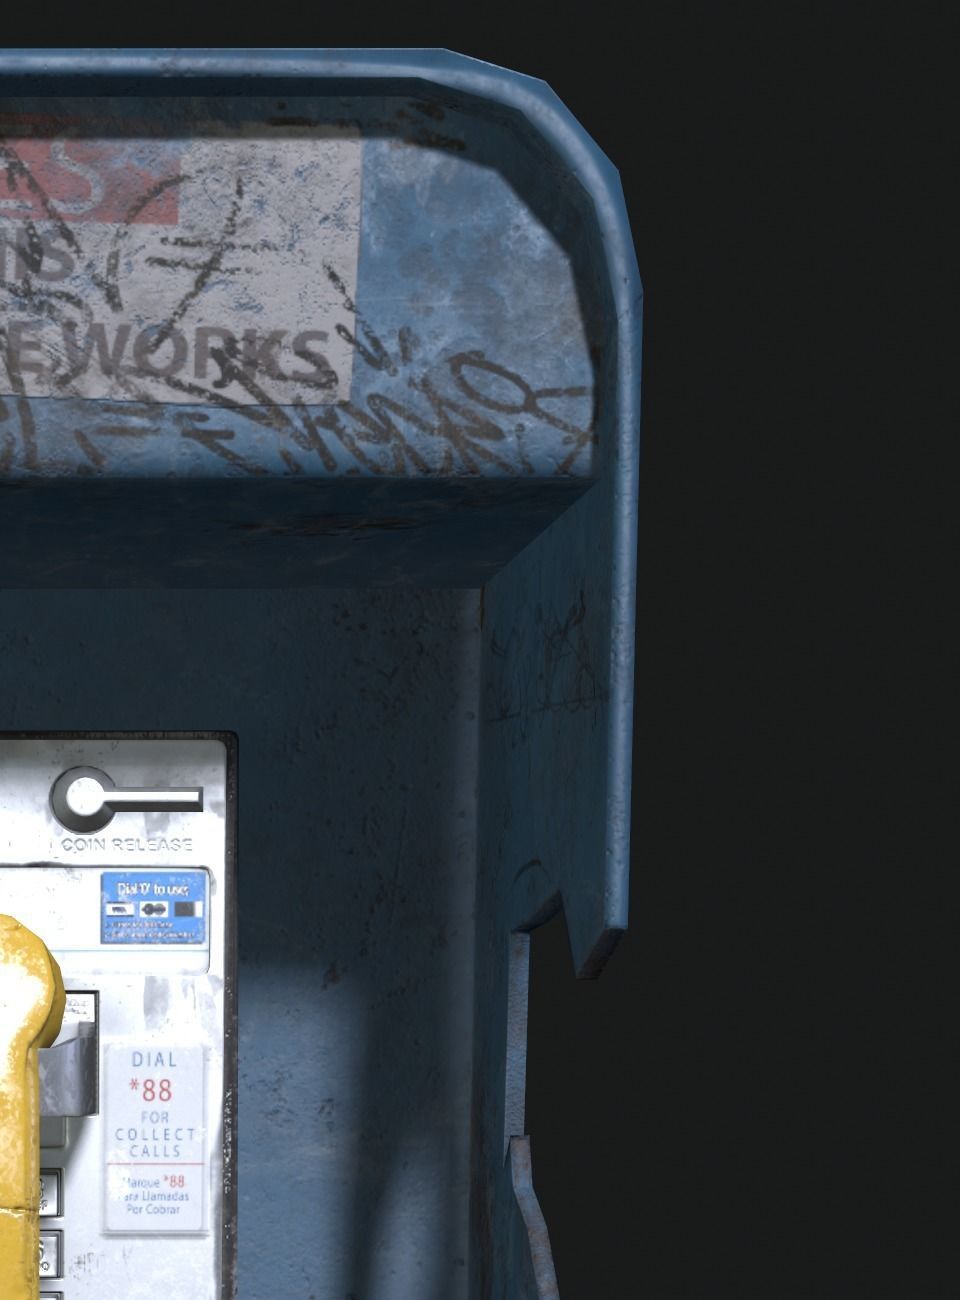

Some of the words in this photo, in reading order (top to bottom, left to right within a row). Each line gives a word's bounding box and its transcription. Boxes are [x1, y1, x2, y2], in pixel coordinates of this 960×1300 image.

[59, 322, 339, 390] WORKS
[60, 837, 106, 852] COIN
[111, 837, 193, 852] RELEASE
[131, 1051, 178, 1068] DIAL
[141, 1110, 169, 1124] FOR
[115, 1127, 196, 1141] COLLECT
[128, 1144, 181, 1158] CALLS
[122, 1176, 161, 1189] arque
[119, 1190, 140, 1202] ara
[142, 1189, 190, 1202] Llamadas
[145, 1202, 181, 1215] Cobrar
